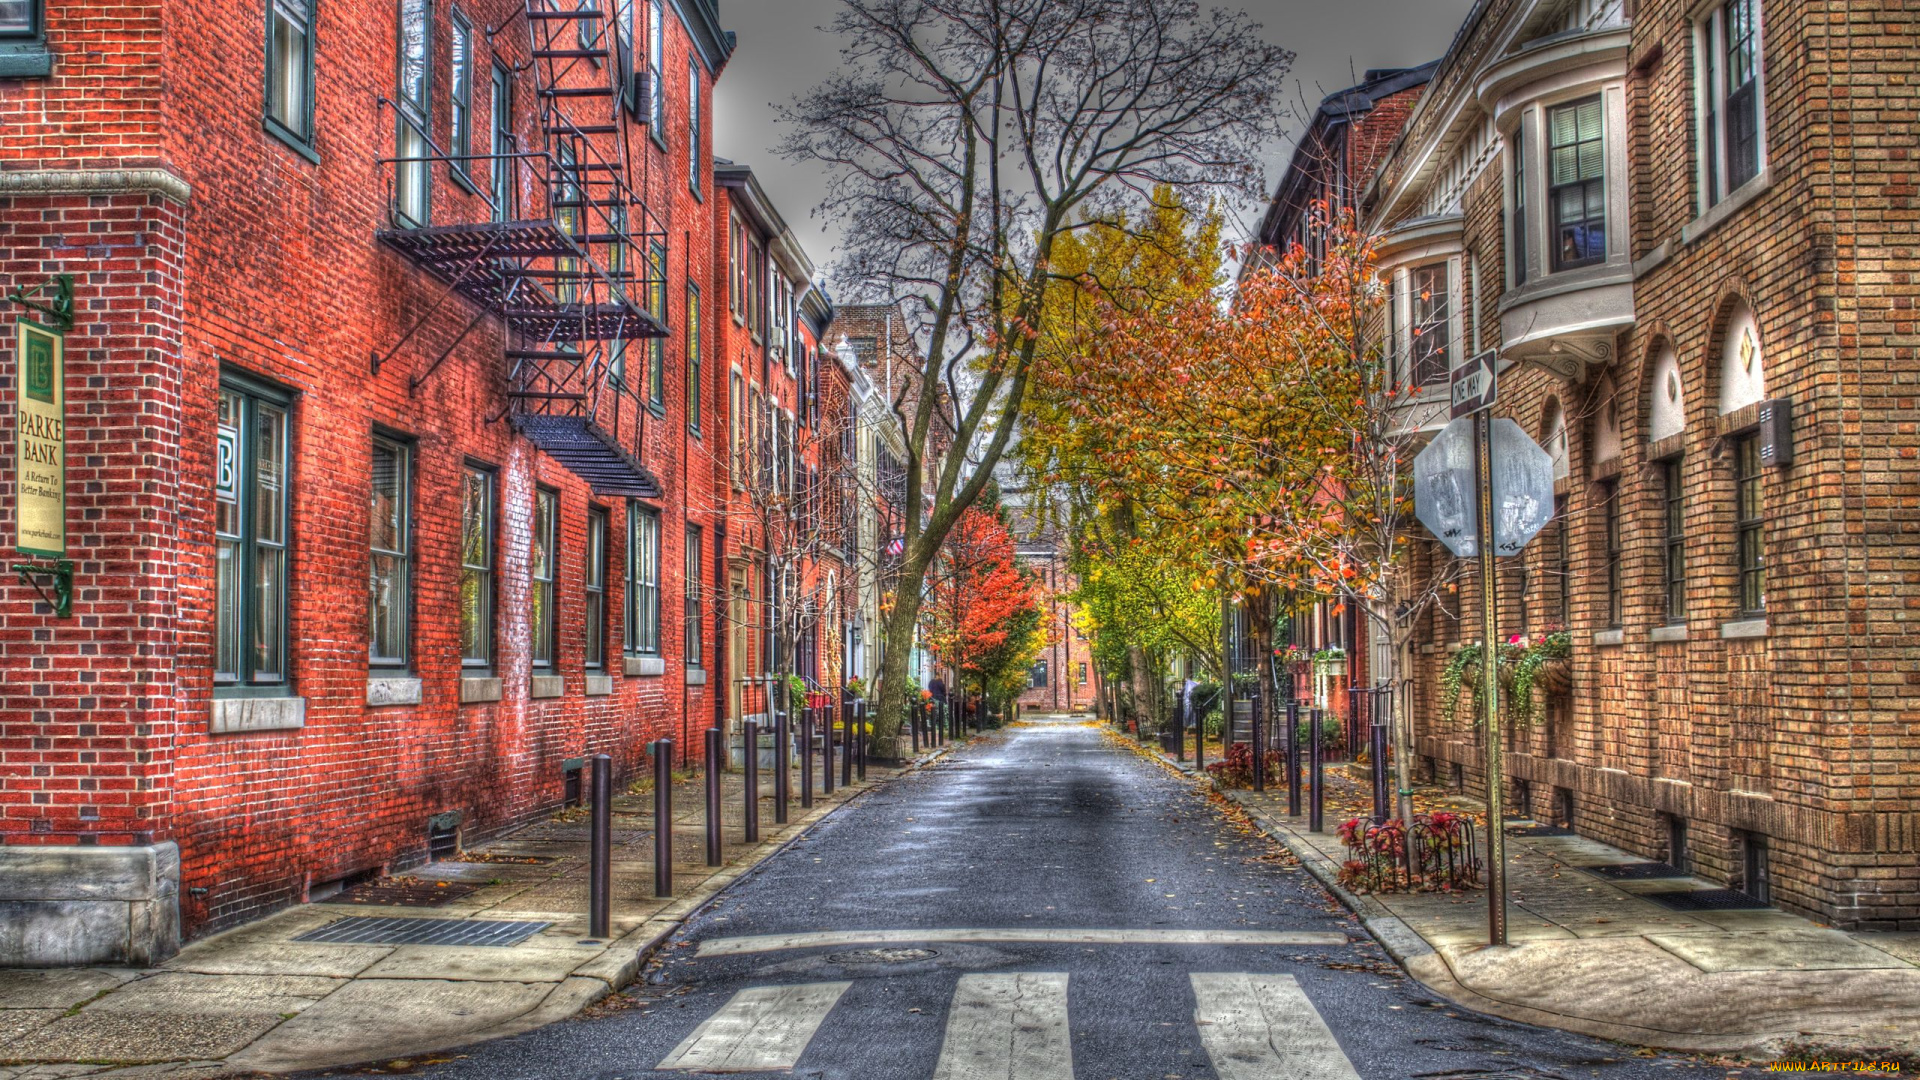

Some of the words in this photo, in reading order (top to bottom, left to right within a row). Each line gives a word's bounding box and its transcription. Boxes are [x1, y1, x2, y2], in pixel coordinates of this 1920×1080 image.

[1453, 380, 1466, 404] ONE
[1466, 372, 1481, 398] WAY
[19, 410, 62, 442] PARKE
[24, 439, 58, 466] BANK
[25, 470, 30, 481] A
[31, 471, 49, 484] Return
[50, 474, 58, 486] To
[21, 483, 38, 495] Better
[38, 486, 61, 503] Banking
